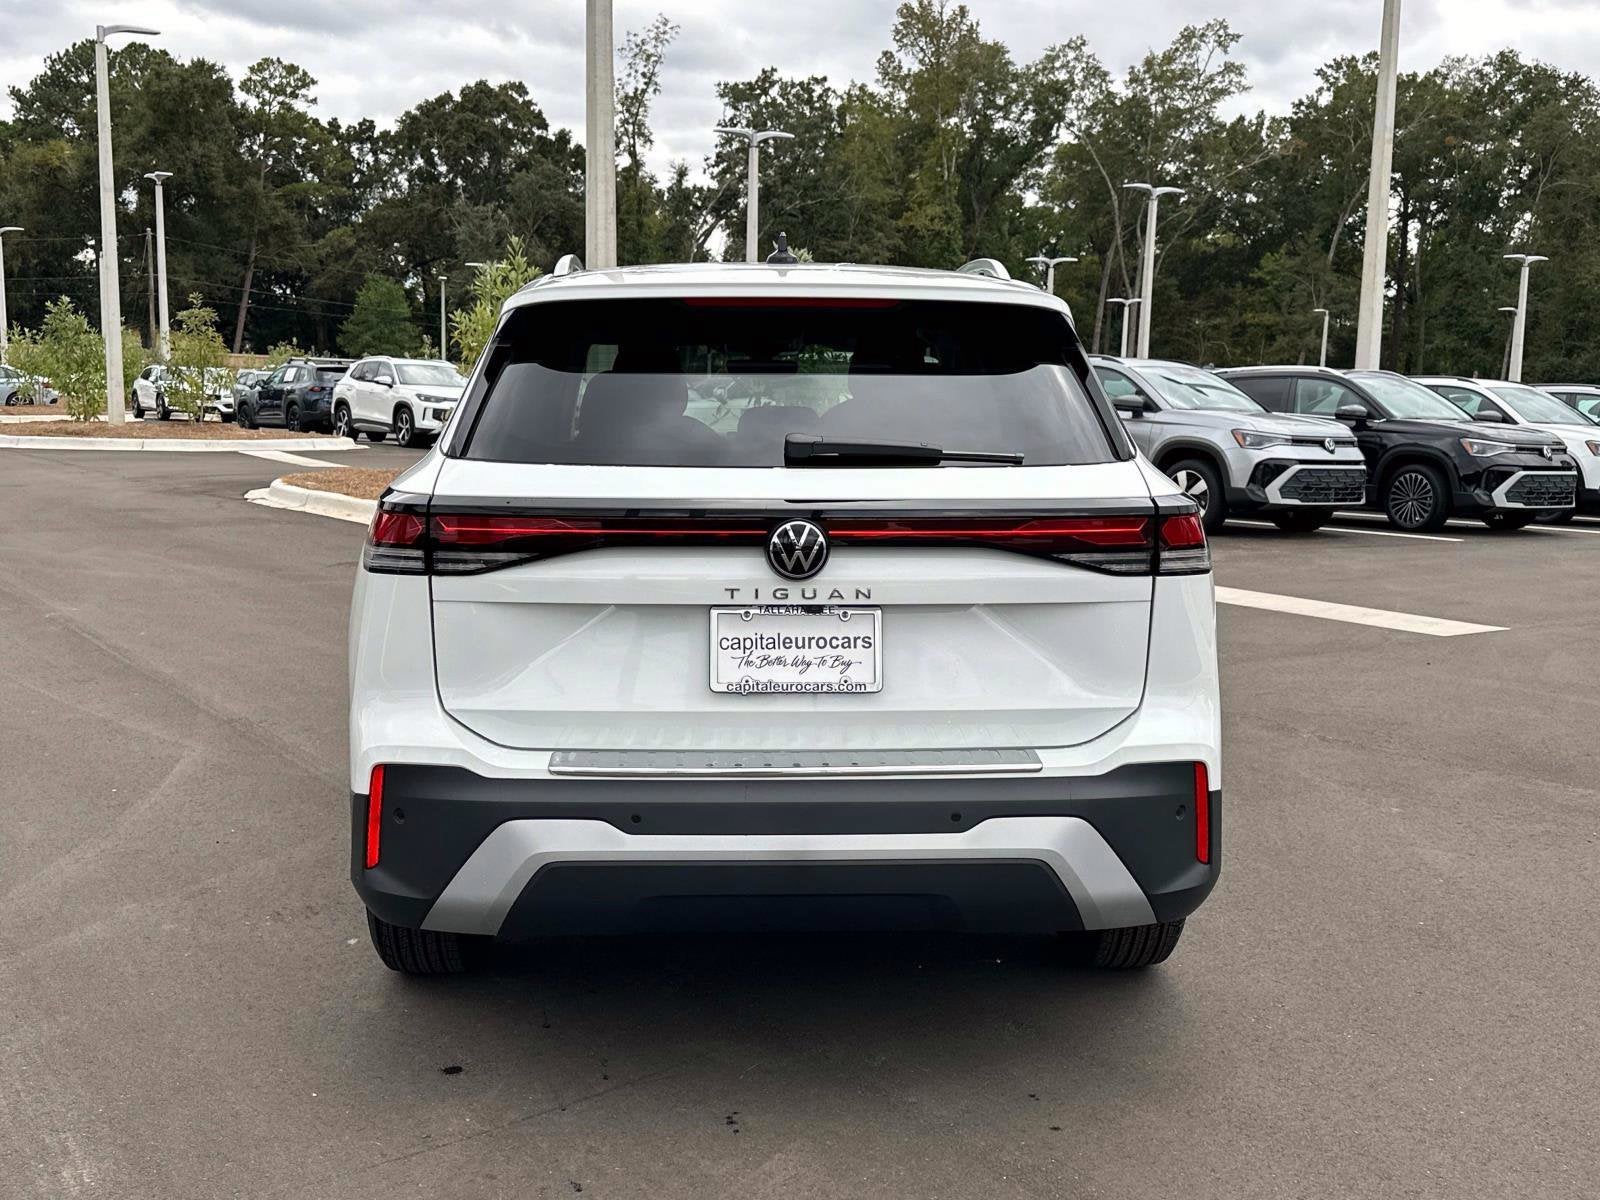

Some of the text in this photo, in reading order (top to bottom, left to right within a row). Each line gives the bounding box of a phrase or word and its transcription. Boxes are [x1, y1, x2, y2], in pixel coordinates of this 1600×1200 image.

[768, 520, 828, 578] VW
[724, 588, 872, 600] TIGUAN
[758, 605, 836, 615] TALLAHAEE
[719, 632, 873, 655] capitaleurocars
[731, 650, 863, 675] The Better Way To Buy
[726, 681, 867, 695] capitaleurocars.com
